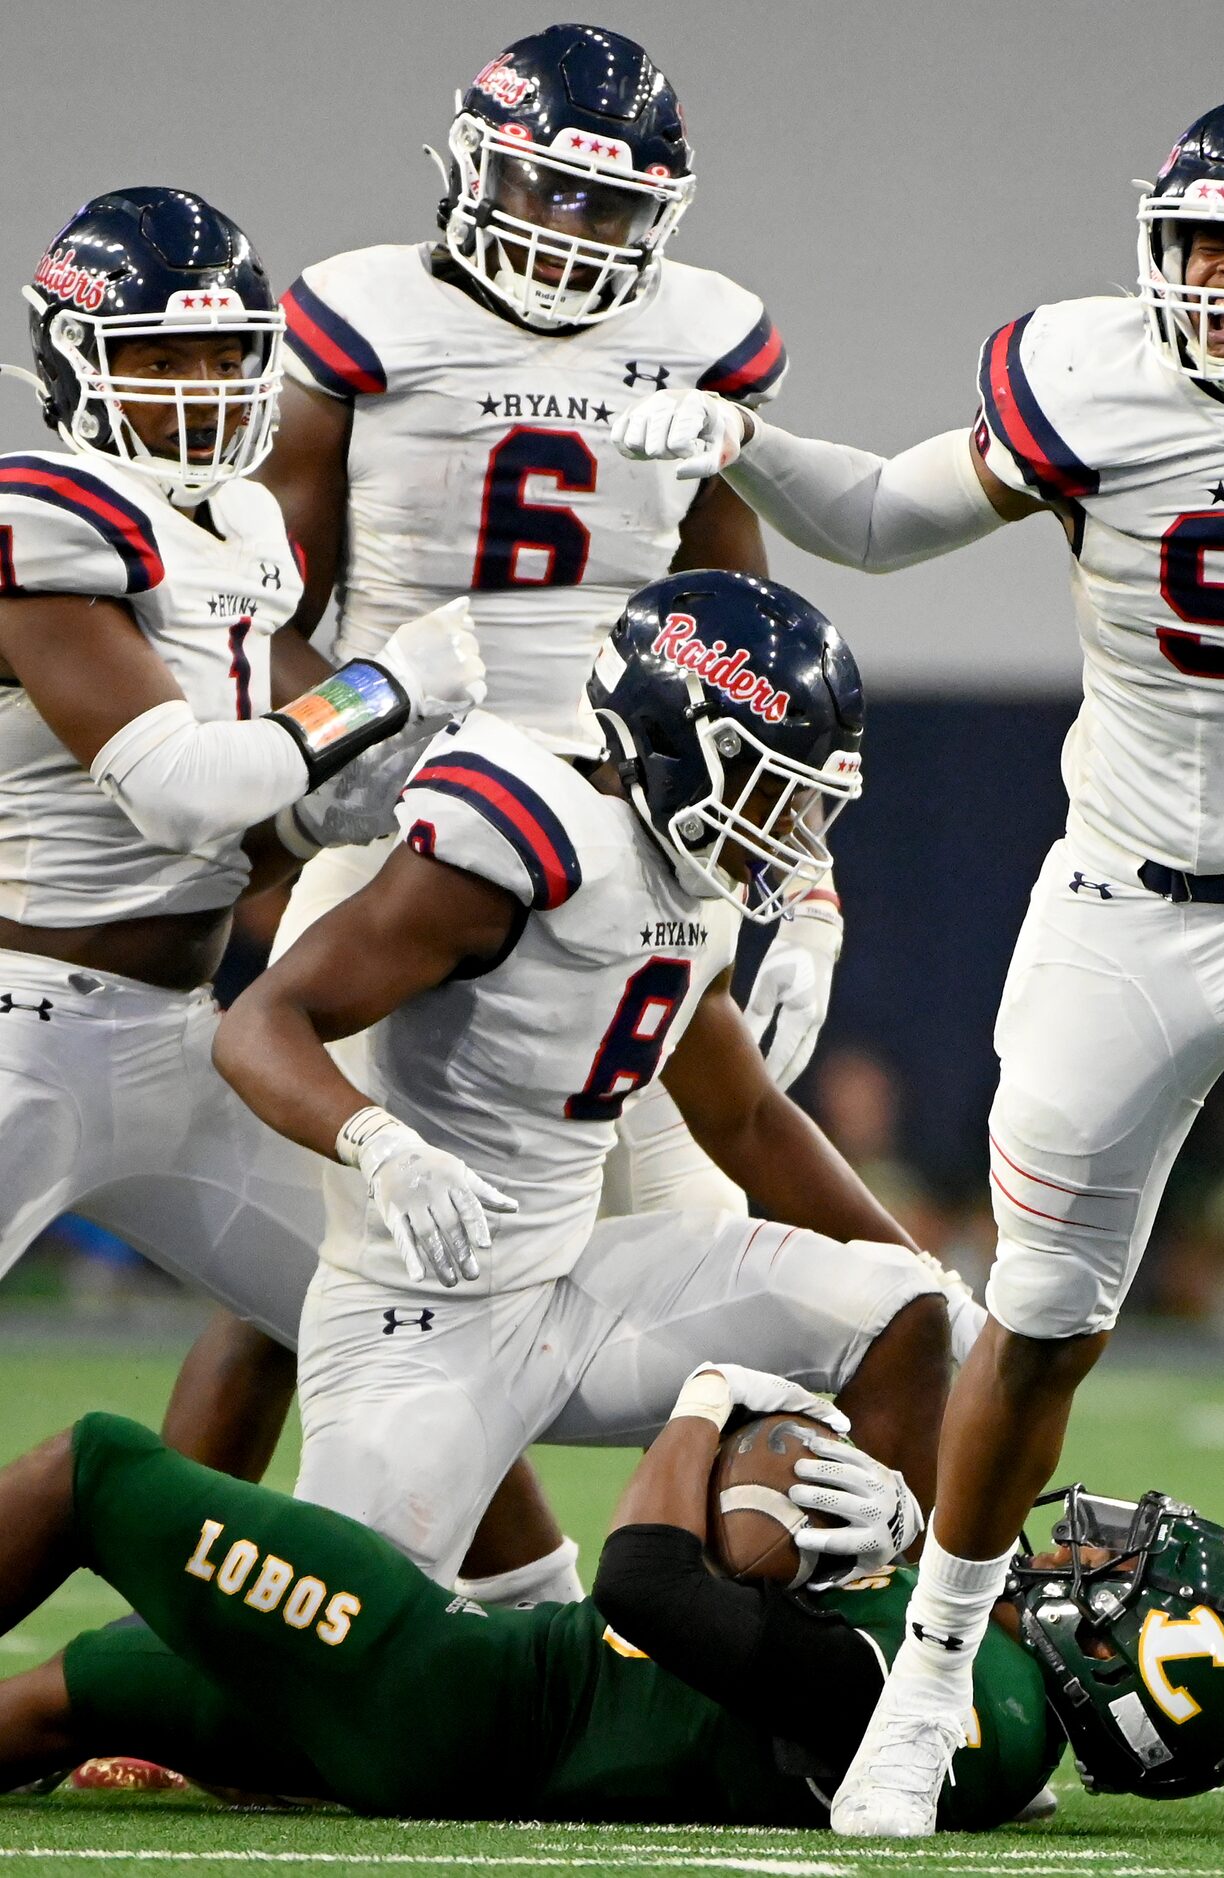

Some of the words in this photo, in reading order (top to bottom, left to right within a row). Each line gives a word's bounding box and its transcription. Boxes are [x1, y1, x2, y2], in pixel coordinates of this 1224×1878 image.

[503, 394, 590, 420] RYAN
[471, 424, 598, 590] 6
[218, 593, 252, 618] RYAN
[651, 612, 791, 724] Raiders
[654, 921, 700, 947] RYAN
[564, 956, 692, 1120] 8
[184, 1518, 362, 1647] LOBOS
